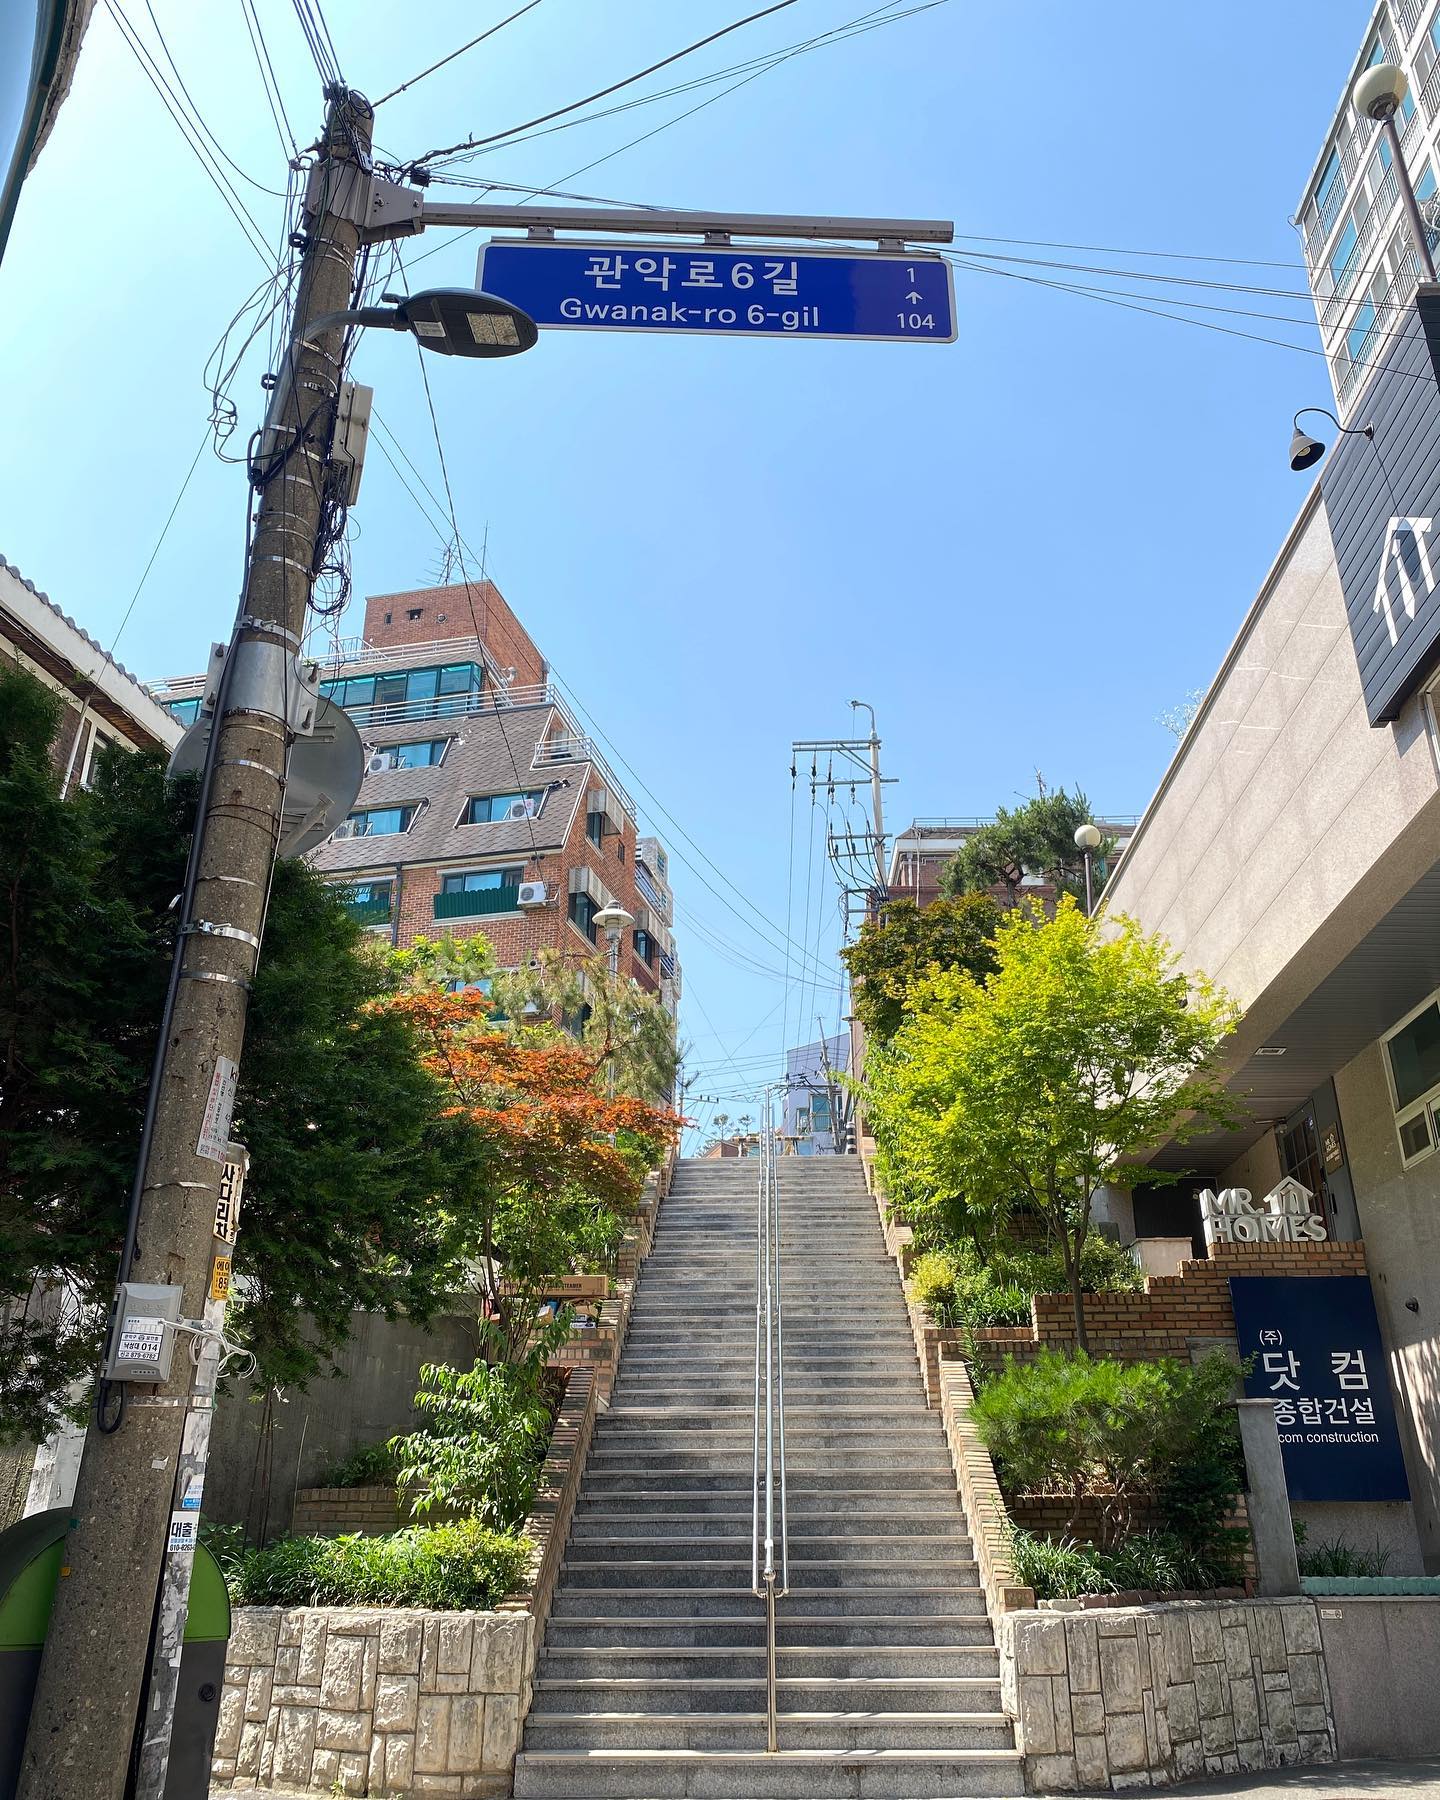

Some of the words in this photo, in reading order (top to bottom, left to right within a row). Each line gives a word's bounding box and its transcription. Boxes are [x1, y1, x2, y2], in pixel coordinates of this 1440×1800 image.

[906, 267, 916, 283] 1
[559, 298, 737, 324] Gwanak-ro
[747, 304, 819, 330] 6-gil
[896, 312, 936, 331] 104
[213, 1163, 235, 1240] 사다리차
[1200, 1187, 1265, 1215] MR.
[1203, 1215, 1327, 1243] HOMES
[141, 1343, 158, 1351] 014
[1259, 1329, 1283, 1346] (주)
[1273, 1397, 1376, 1426] 종합건설
[1306, 1430, 1379, 1443] construction
[172, 1522, 193, 1537] 대출
